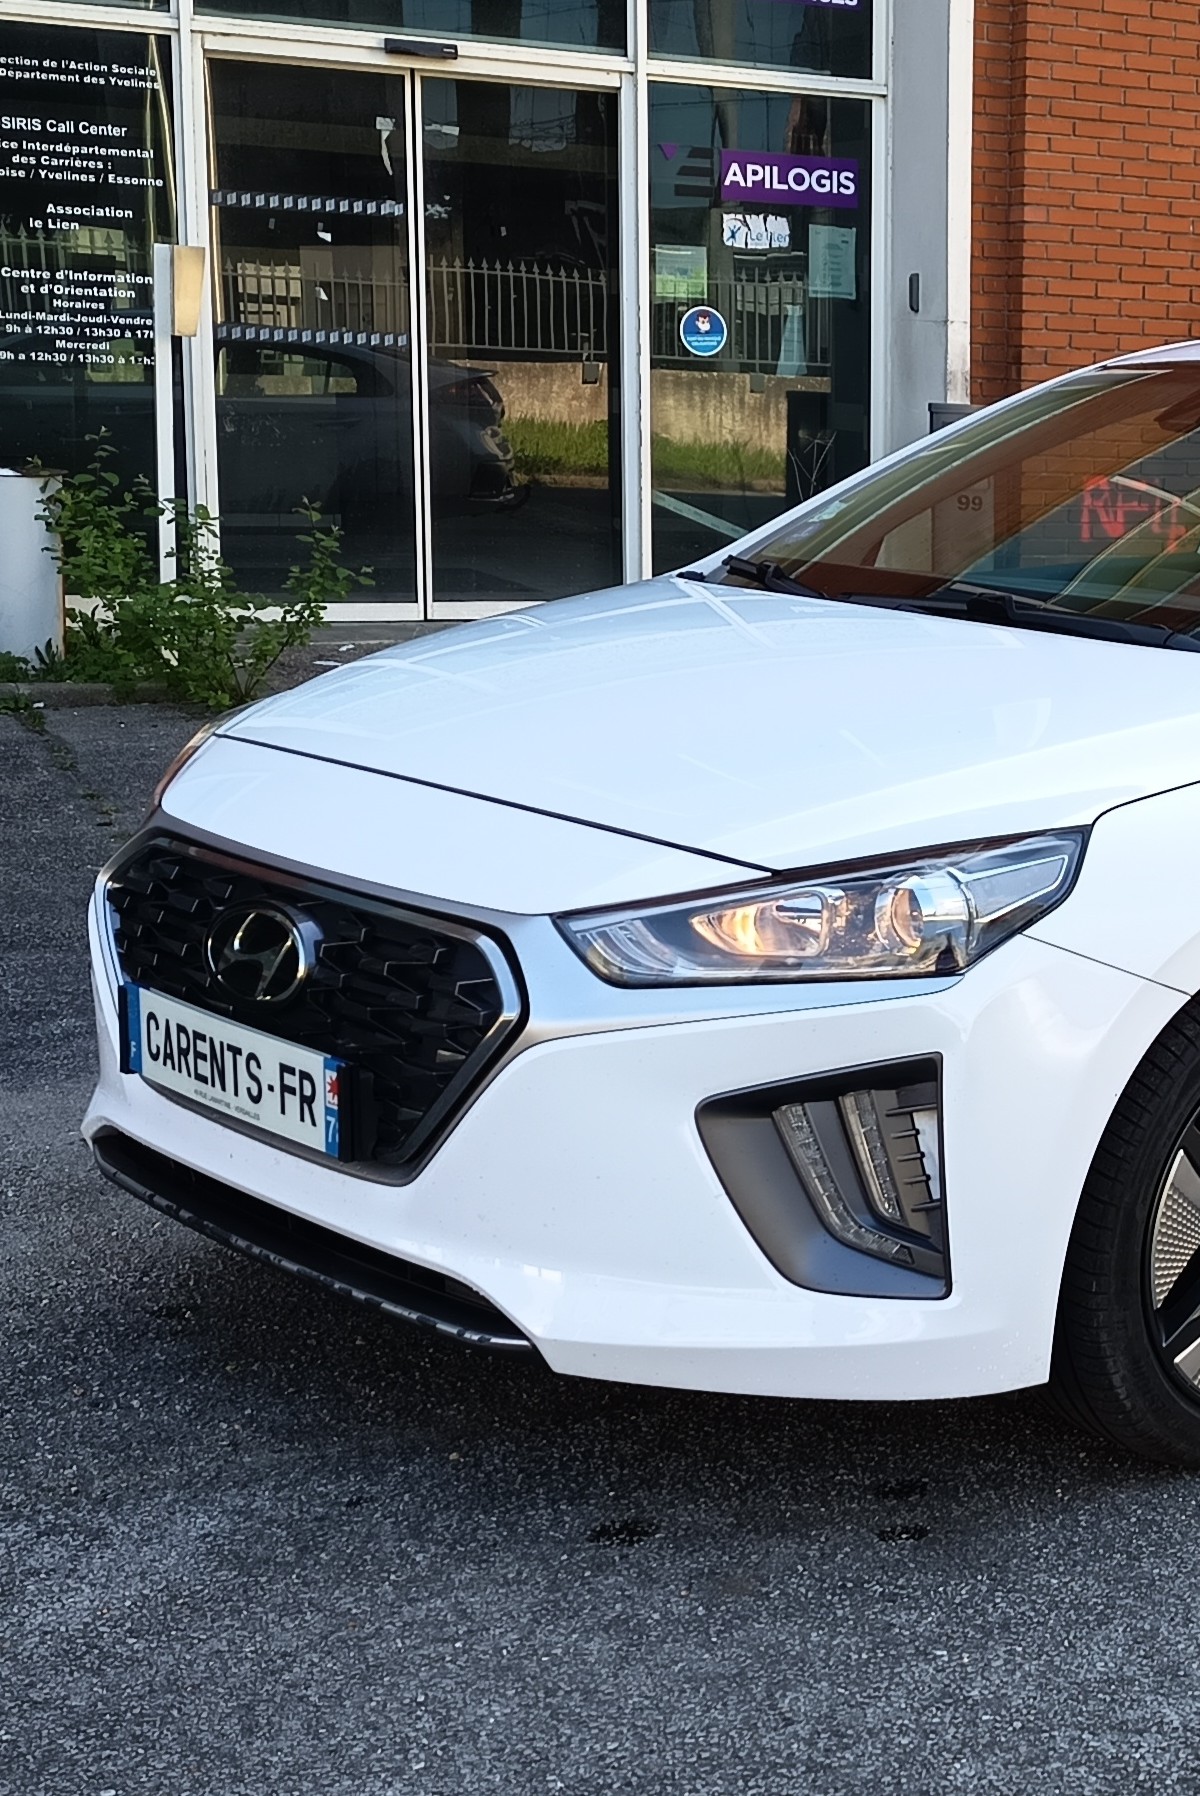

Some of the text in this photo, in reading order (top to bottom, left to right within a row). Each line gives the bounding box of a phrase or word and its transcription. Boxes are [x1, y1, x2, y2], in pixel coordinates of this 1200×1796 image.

[43, 58, 57, 68] de
[62, 60, 108, 72] l'Action
[111, 64, 157, 76] Sociale
[83, 75, 106, 84] des
[109, 77, 160, 89] Yvelines
[1, 116, 128, 137] SIRIS Call Center
[22, 139, 154, 159] Interdépartemental
[12, 154, 36, 165] des
[40, 155, 104, 169] Carrières
[38, 169, 96, 182] Yvelines
[108, 173, 164, 187] Essonne
[723, 162, 856, 195] APILOGIS
[46, 203, 133, 219] Association
[29, 217, 80, 230] le Lien
[1, 267, 153, 285] Centre d'Information
[20, 284, 136, 298] et d'Orientation
[53, 299, 105, 310] Horaires
[5, 324, 21, 333] 9h
[36, 326, 74, 336] 12h30
[84, 328, 121, 338] 13h30
[55, 340, 110, 351] Mercredi
[29, 352, 67, 362] 12h30
[78, 353, 115, 364] 13h30
[957, 494, 983, 512] 99
[129, 1041, 137, 1058] F
[146, 1011, 317, 1127] CARENTS-FR
